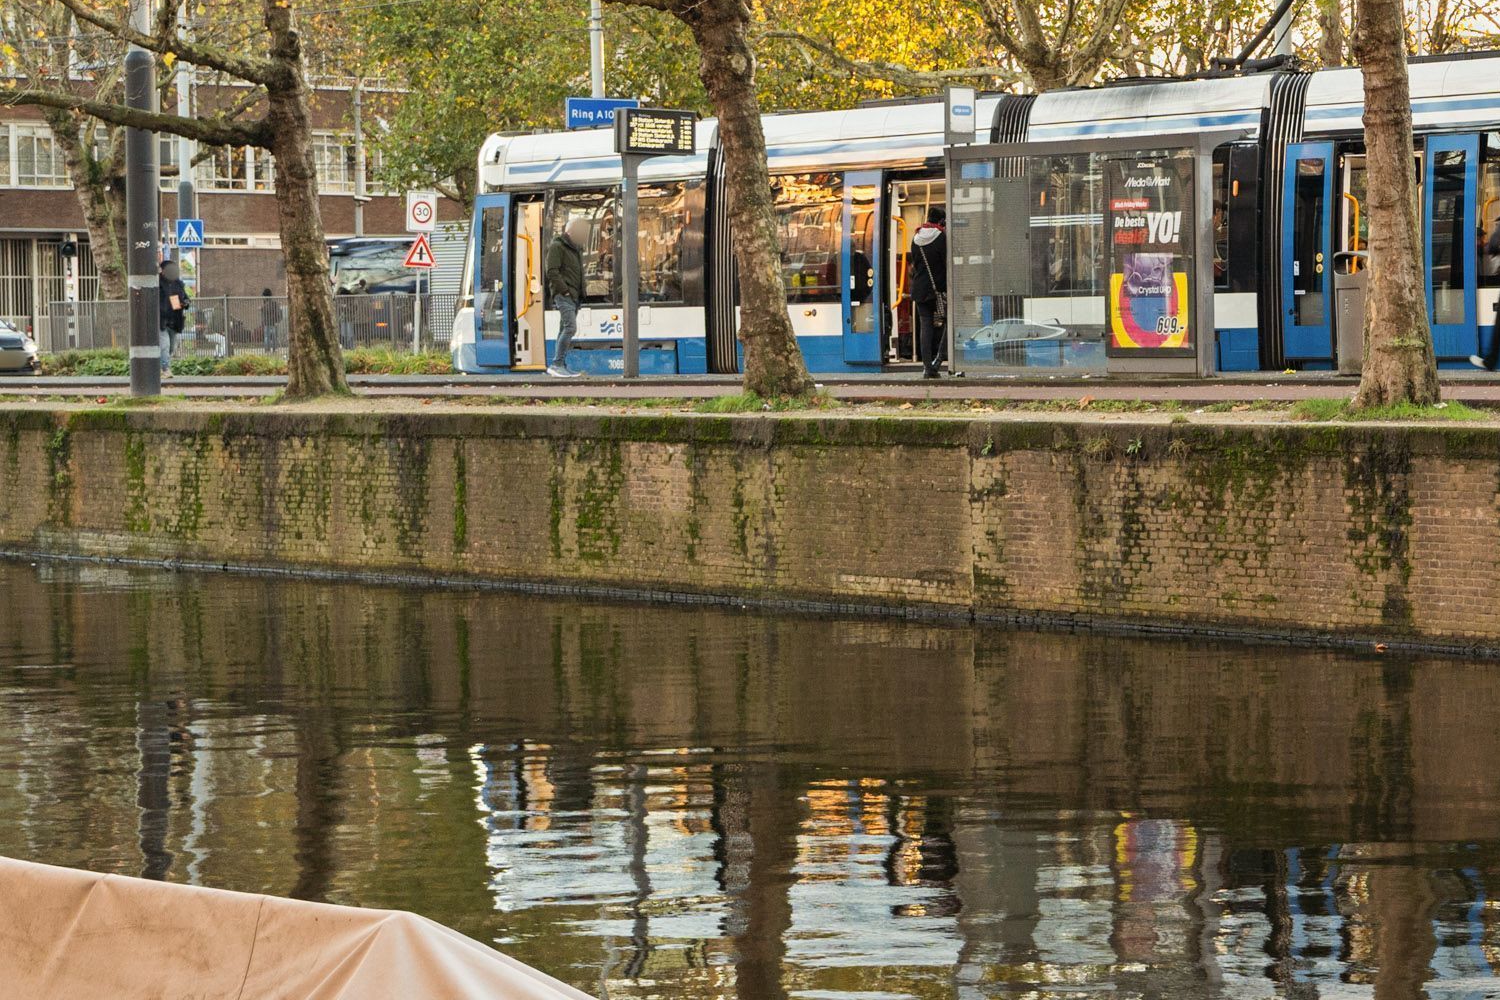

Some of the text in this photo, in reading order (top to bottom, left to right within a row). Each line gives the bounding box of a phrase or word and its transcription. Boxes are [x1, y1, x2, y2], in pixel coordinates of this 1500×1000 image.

[572, 109, 614, 120] Ring A10
[416, 207, 429, 216] 30
[1114, 216, 1146, 228] De beste
[1146, 211, 1182, 244] YO!
[1139, 286, 1160, 296] Crystal
[1156, 317, 1184, 334] 699.-
